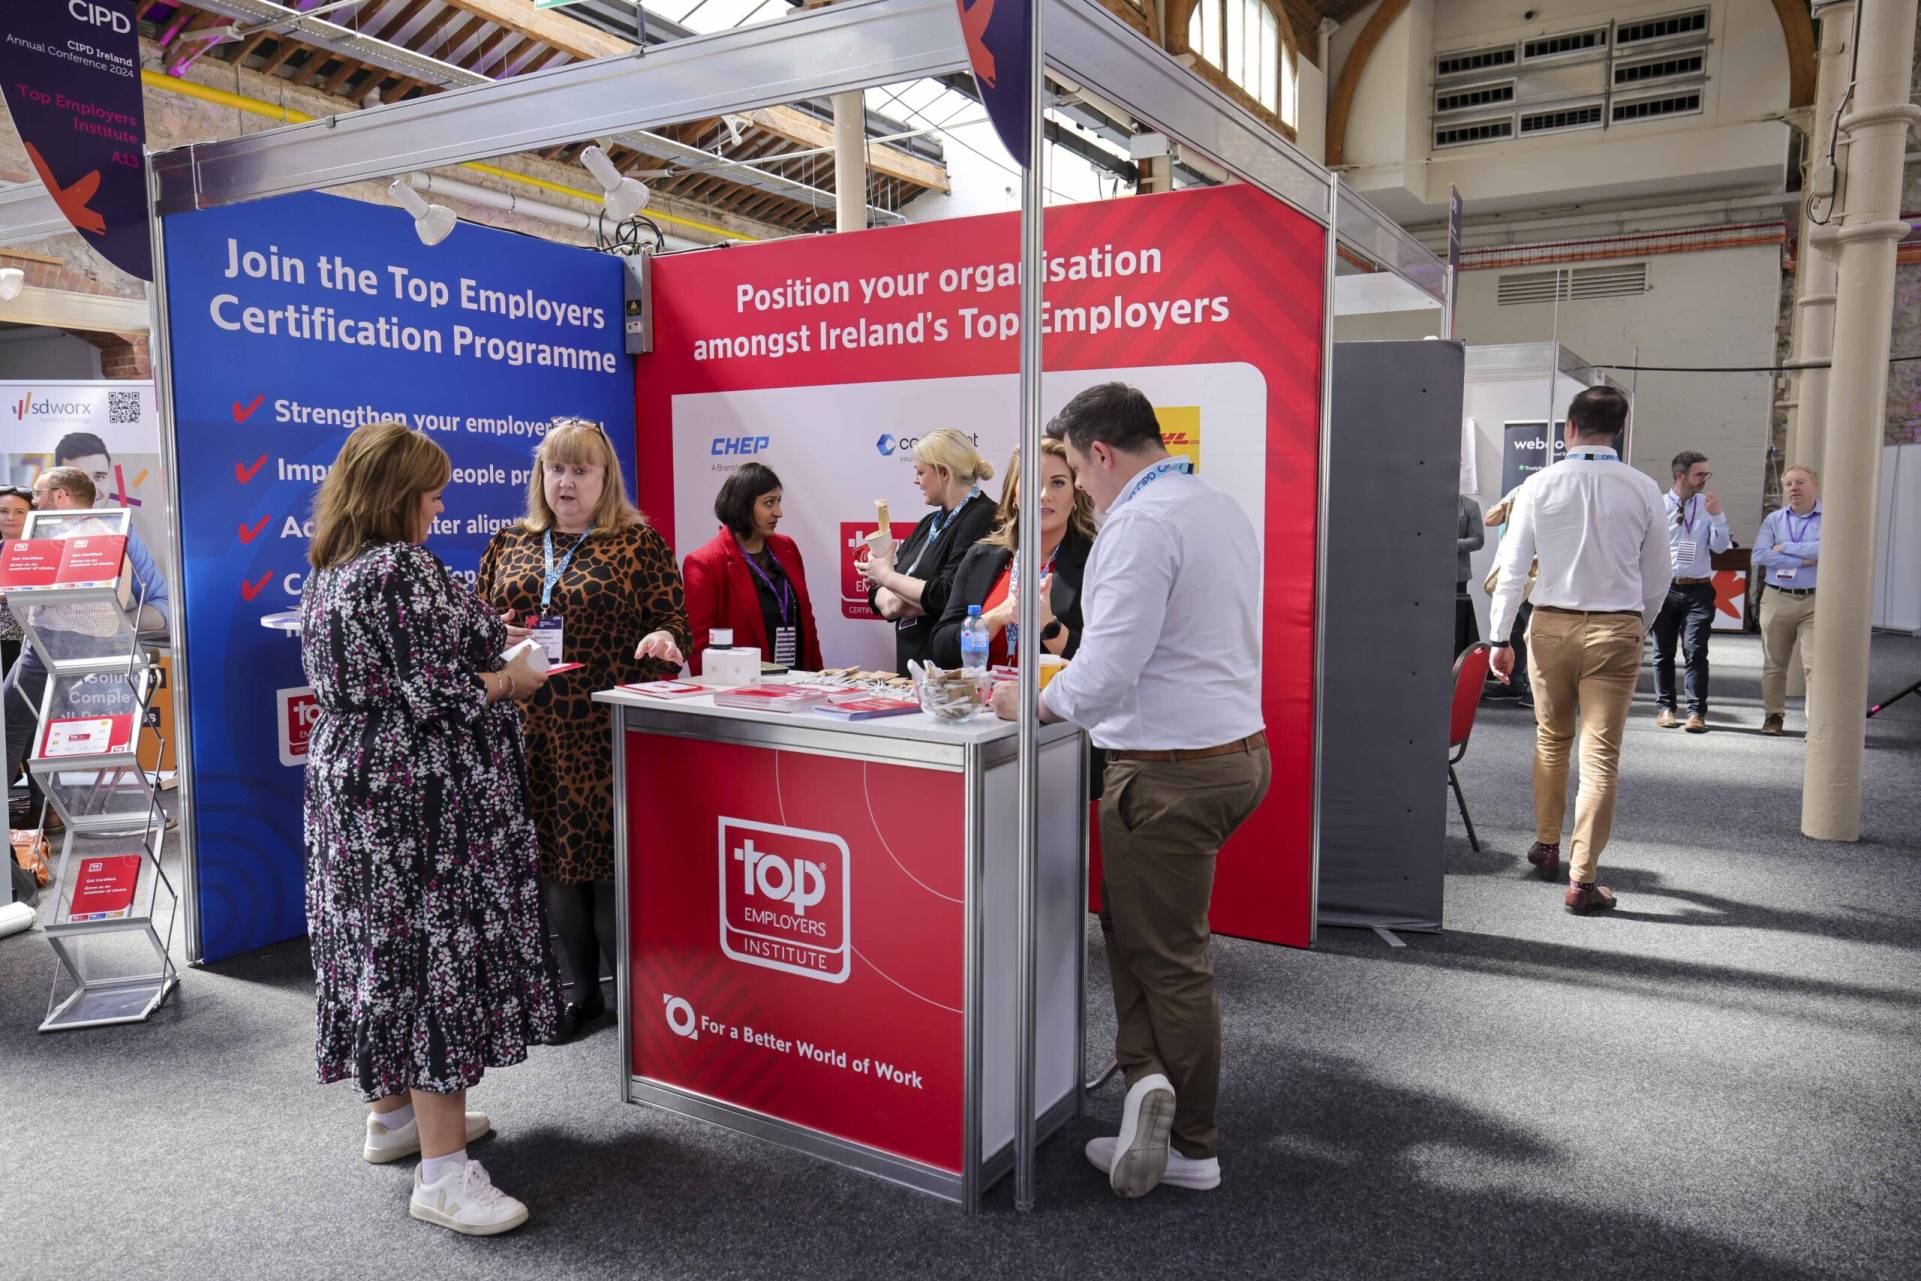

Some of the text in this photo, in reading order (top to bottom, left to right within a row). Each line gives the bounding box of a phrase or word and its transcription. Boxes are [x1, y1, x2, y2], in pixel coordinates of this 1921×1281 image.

[68, 0, 131, 34] CIPD
[6, 33, 134, 78] Annual Conference 2024
[67, 40, 133, 67] CIPD Ireland
[17, 83, 137, 126] Top Employers
[73, 117, 137, 143] Institute
[112, 151, 139, 168] A13
[225, 238, 605, 329] Join the Top Employers
[737, 273, 849, 313] Position
[859, 272, 929, 304] your
[210, 294, 616, 373] Certification Programme
[694, 296, 1229, 361] amongst Ireland’s Top Employers
[31, 399, 91, 414] sdworx
[274, 400, 407, 428] Strengthen
[413, 414, 460, 432] your
[711, 436, 770, 455] CHEP
[449, 464, 506, 486] eople
[744, 907, 826, 937] EMPLOYERS
[744, 938, 827, 969] INSTITUTE
[701, 1015, 923, 1090] For a Better World of Work
